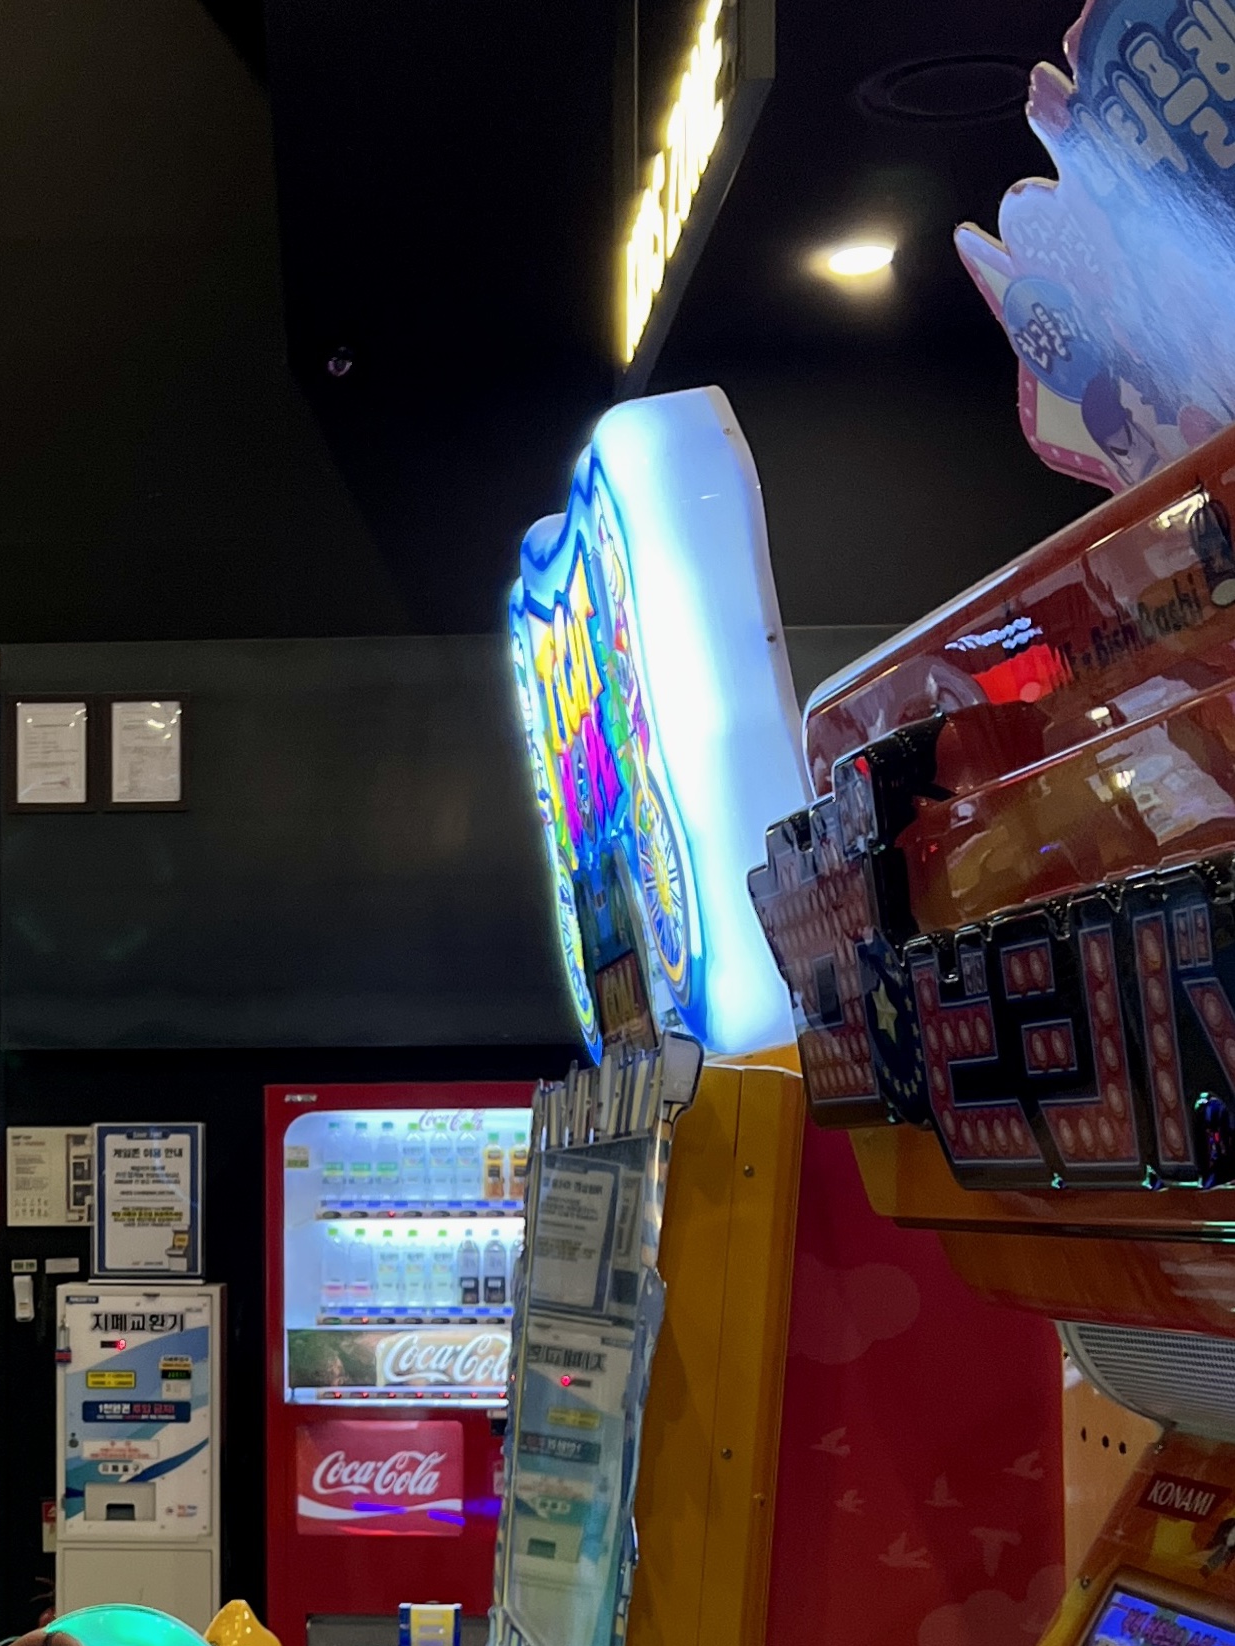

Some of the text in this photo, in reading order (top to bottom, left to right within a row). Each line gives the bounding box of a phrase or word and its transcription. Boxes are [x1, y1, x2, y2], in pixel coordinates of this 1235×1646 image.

[90, 1312, 187, 1333] 지폐교환기
[311, 1450, 447, 1497] Coca-Cola
[1147, 1479, 1216, 1516] KONAMI
